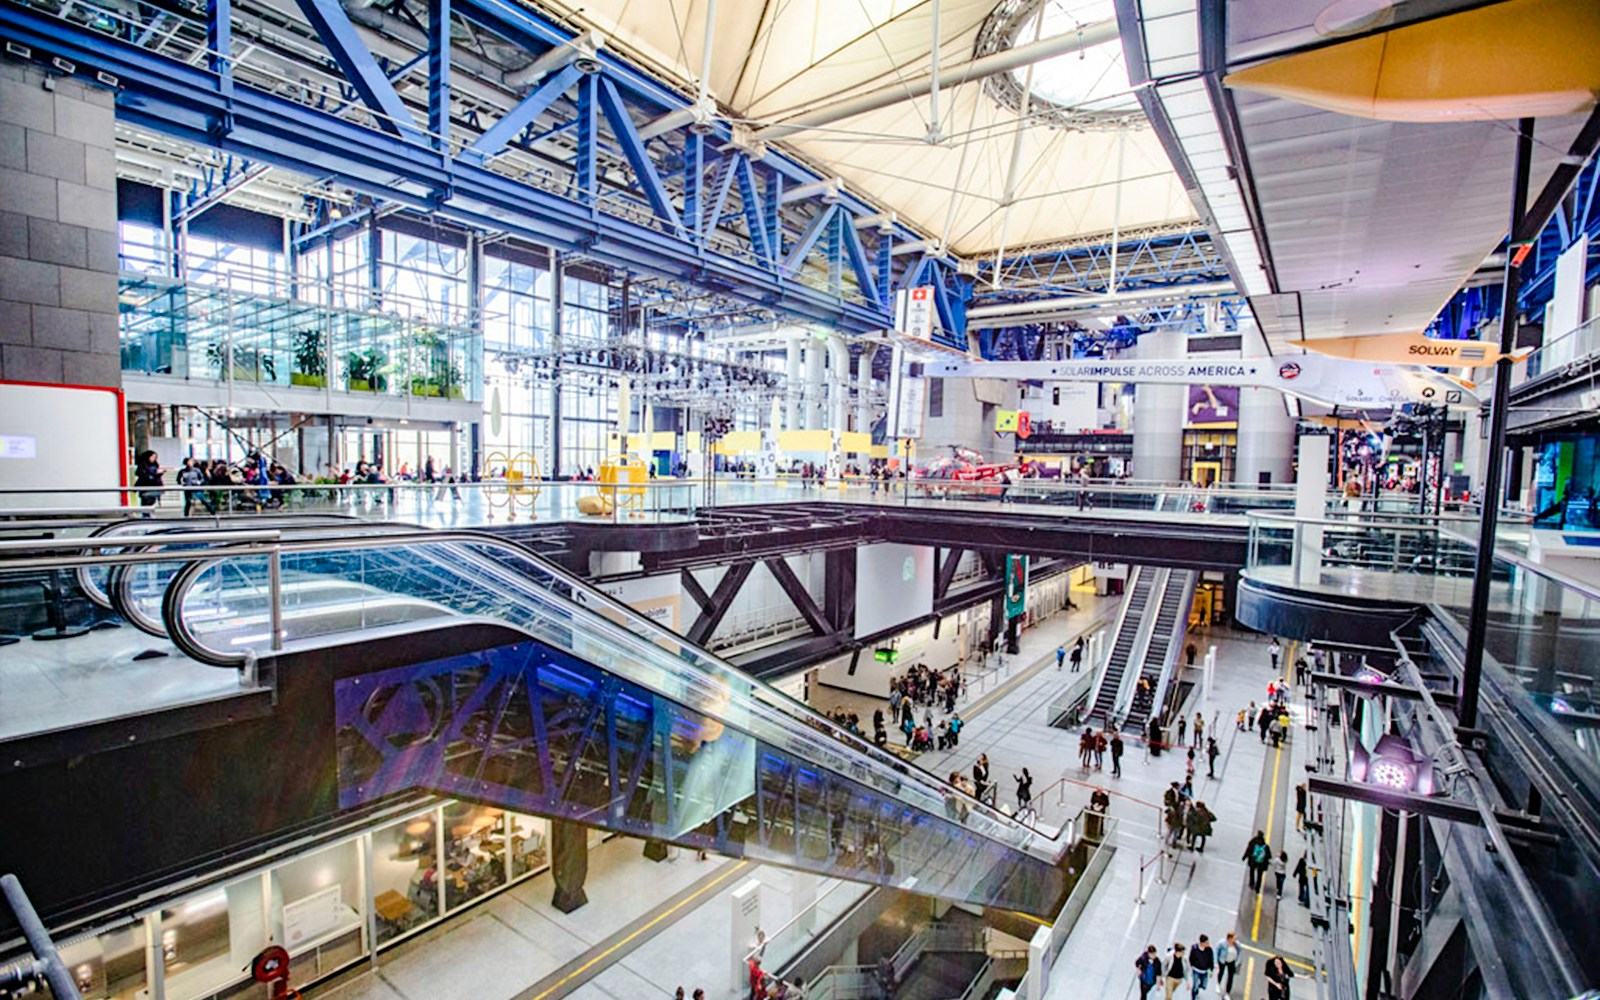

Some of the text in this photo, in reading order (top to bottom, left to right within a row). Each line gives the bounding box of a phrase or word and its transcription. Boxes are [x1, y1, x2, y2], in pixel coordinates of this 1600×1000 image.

[1408, 345, 1457, 355] SOLVAY
[1060, 366, 1245, 376] SOLARIMPULSE ACROSS AMERICA
